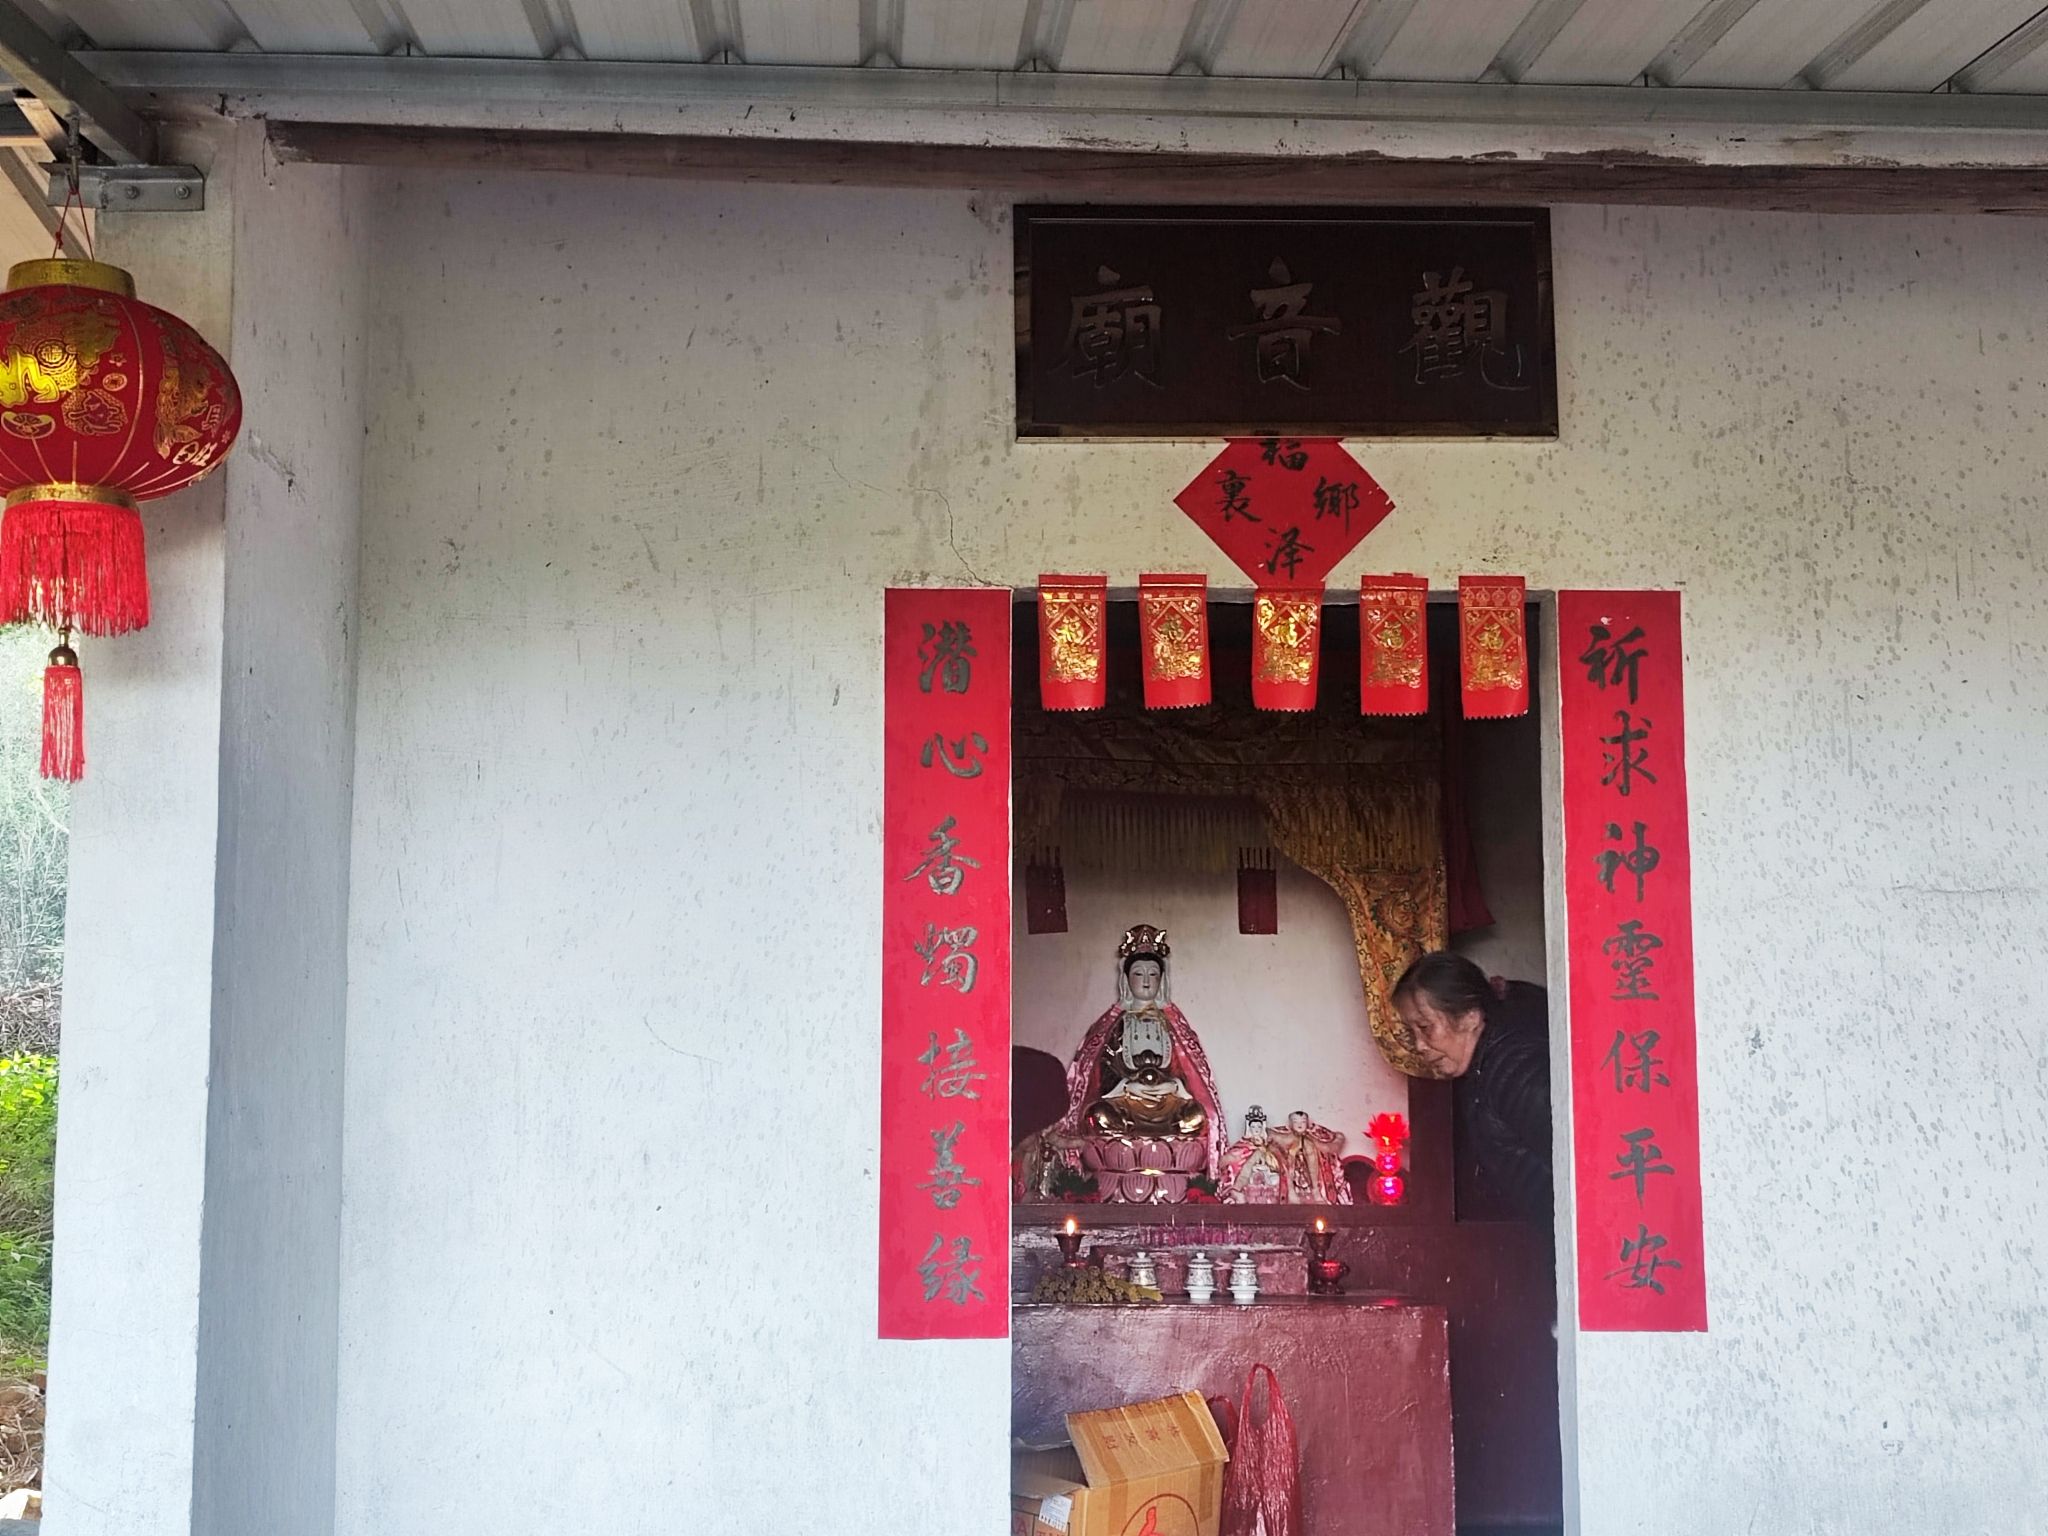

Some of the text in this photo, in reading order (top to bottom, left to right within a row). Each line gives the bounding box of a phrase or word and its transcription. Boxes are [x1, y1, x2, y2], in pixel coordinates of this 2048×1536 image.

[1578, 625, 1683, 1296] 祈求神靈保平安
